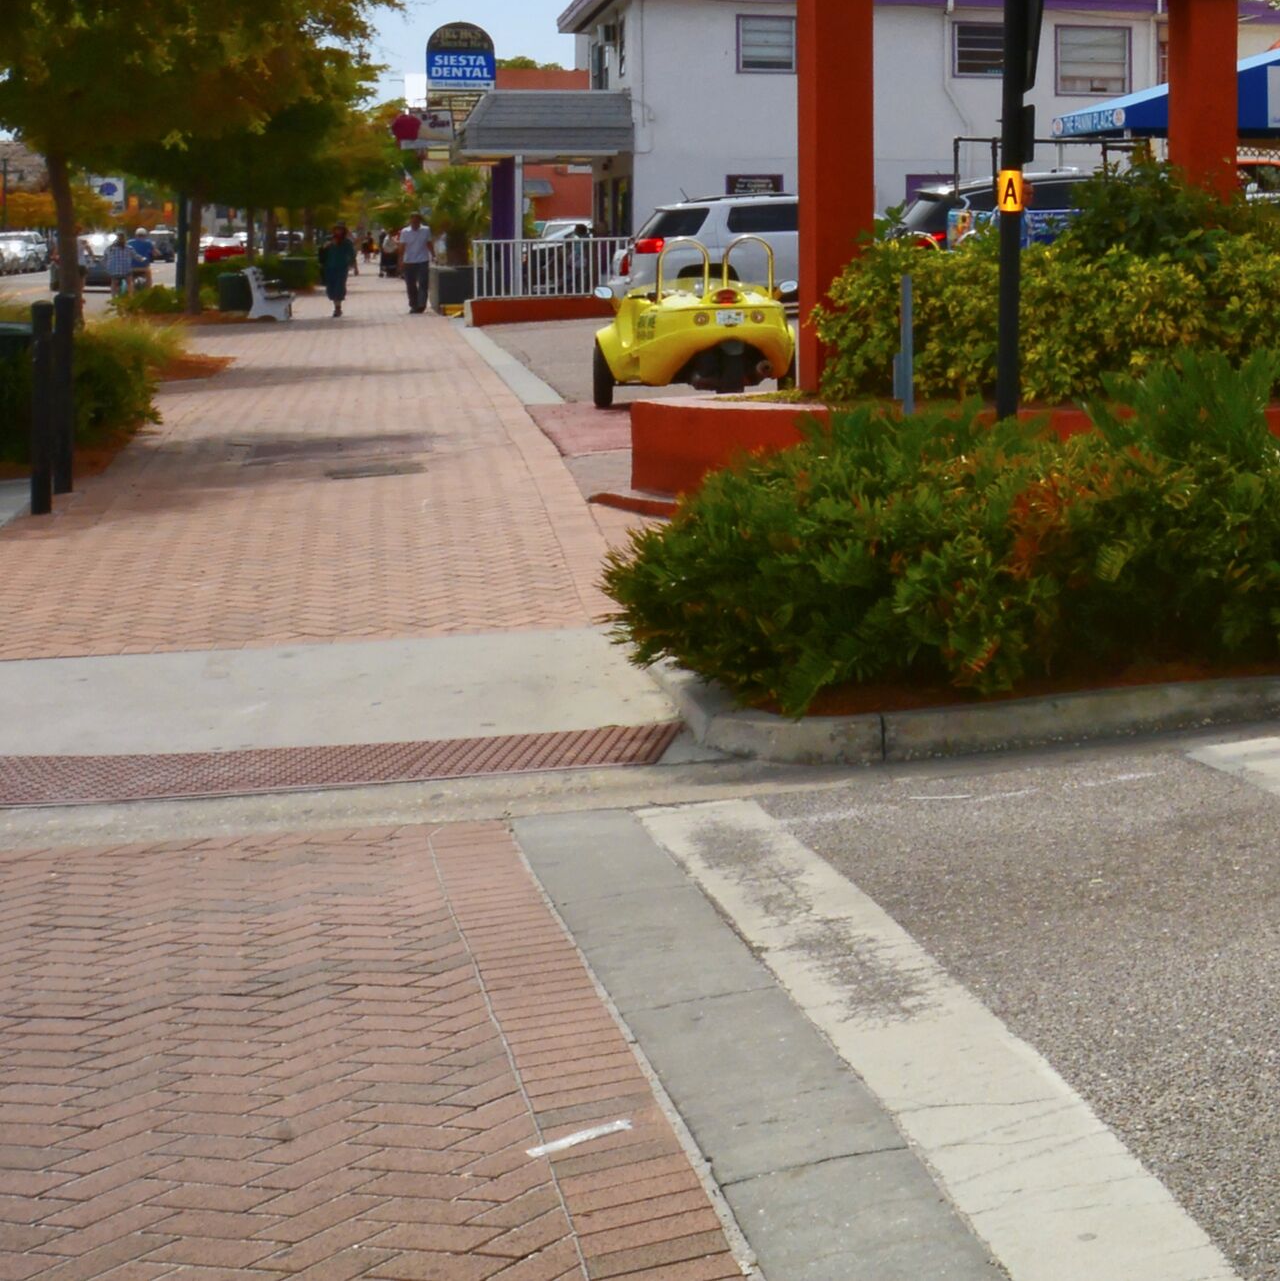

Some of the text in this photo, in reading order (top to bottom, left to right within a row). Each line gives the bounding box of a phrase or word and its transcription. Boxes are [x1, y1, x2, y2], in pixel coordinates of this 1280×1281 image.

[434, 54, 486, 66] SIESTA
[431, 66, 491, 78] DENTAL
[1003, 177, 1018, 205] A
